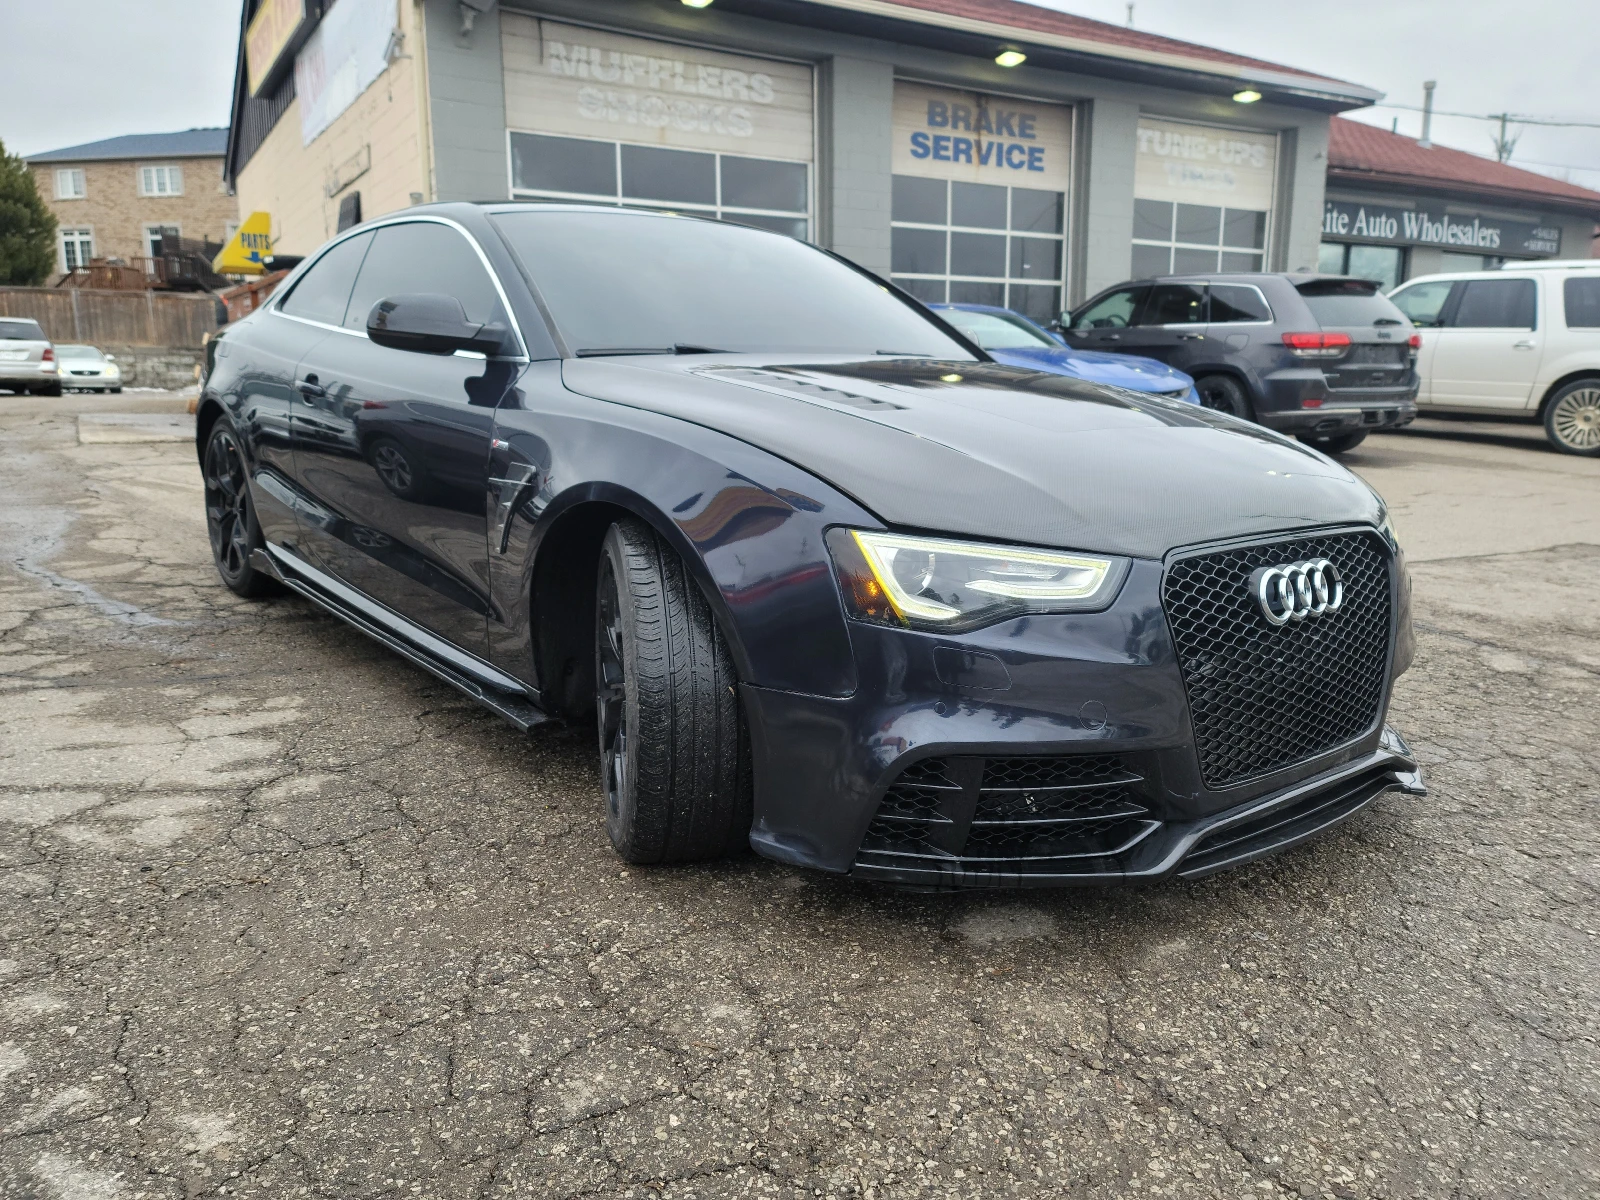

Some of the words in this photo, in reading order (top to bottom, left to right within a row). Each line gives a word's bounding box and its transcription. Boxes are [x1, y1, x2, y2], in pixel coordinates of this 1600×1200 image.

[549, 40, 775, 104] MUFFLERS
[577, 86, 754, 137] SHOCKS
[927, 100, 1036, 139] BRAKE
[910, 131, 1045, 172] SERVICE
[1136, 127, 1267, 168] TUNE-UPS
[241, 232, 271, 251] PARTS
[1351, 206, 1398, 239] Auto
[1402, 210, 1500, 249] Wholesalers
